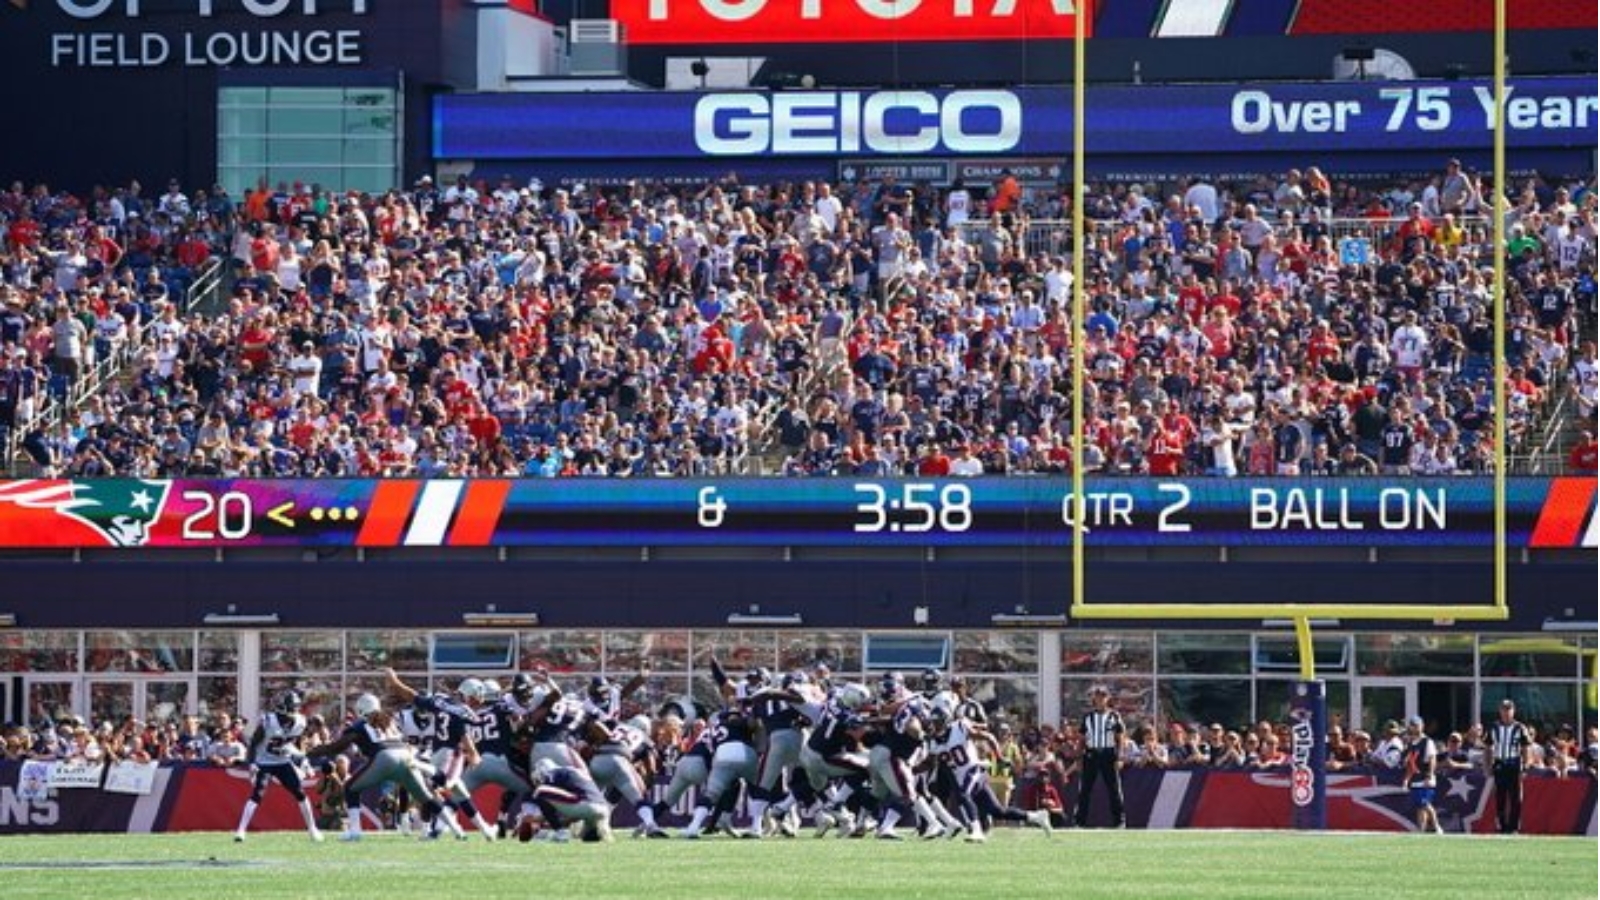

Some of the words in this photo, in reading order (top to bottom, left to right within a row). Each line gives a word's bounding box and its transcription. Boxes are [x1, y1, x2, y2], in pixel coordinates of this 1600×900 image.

[52, 33, 170, 67] FIELD
[185, 30, 362, 65] LOUNGE
[695, 90, 1022, 154] GEICO
[1231, 90, 1361, 133] Over
[1379, 86, 1452, 131] 75
[182, 491, 252, 540] 20
[697, 486, 728, 528] &
[853, 483, 974, 533] 3:58
[1061, 492, 1134, 534] QTR
[1157, 483, 1192, 533] 2
[1250, 488, 1364, 530] BALL
[1378, 488, 1446, 530] ON
